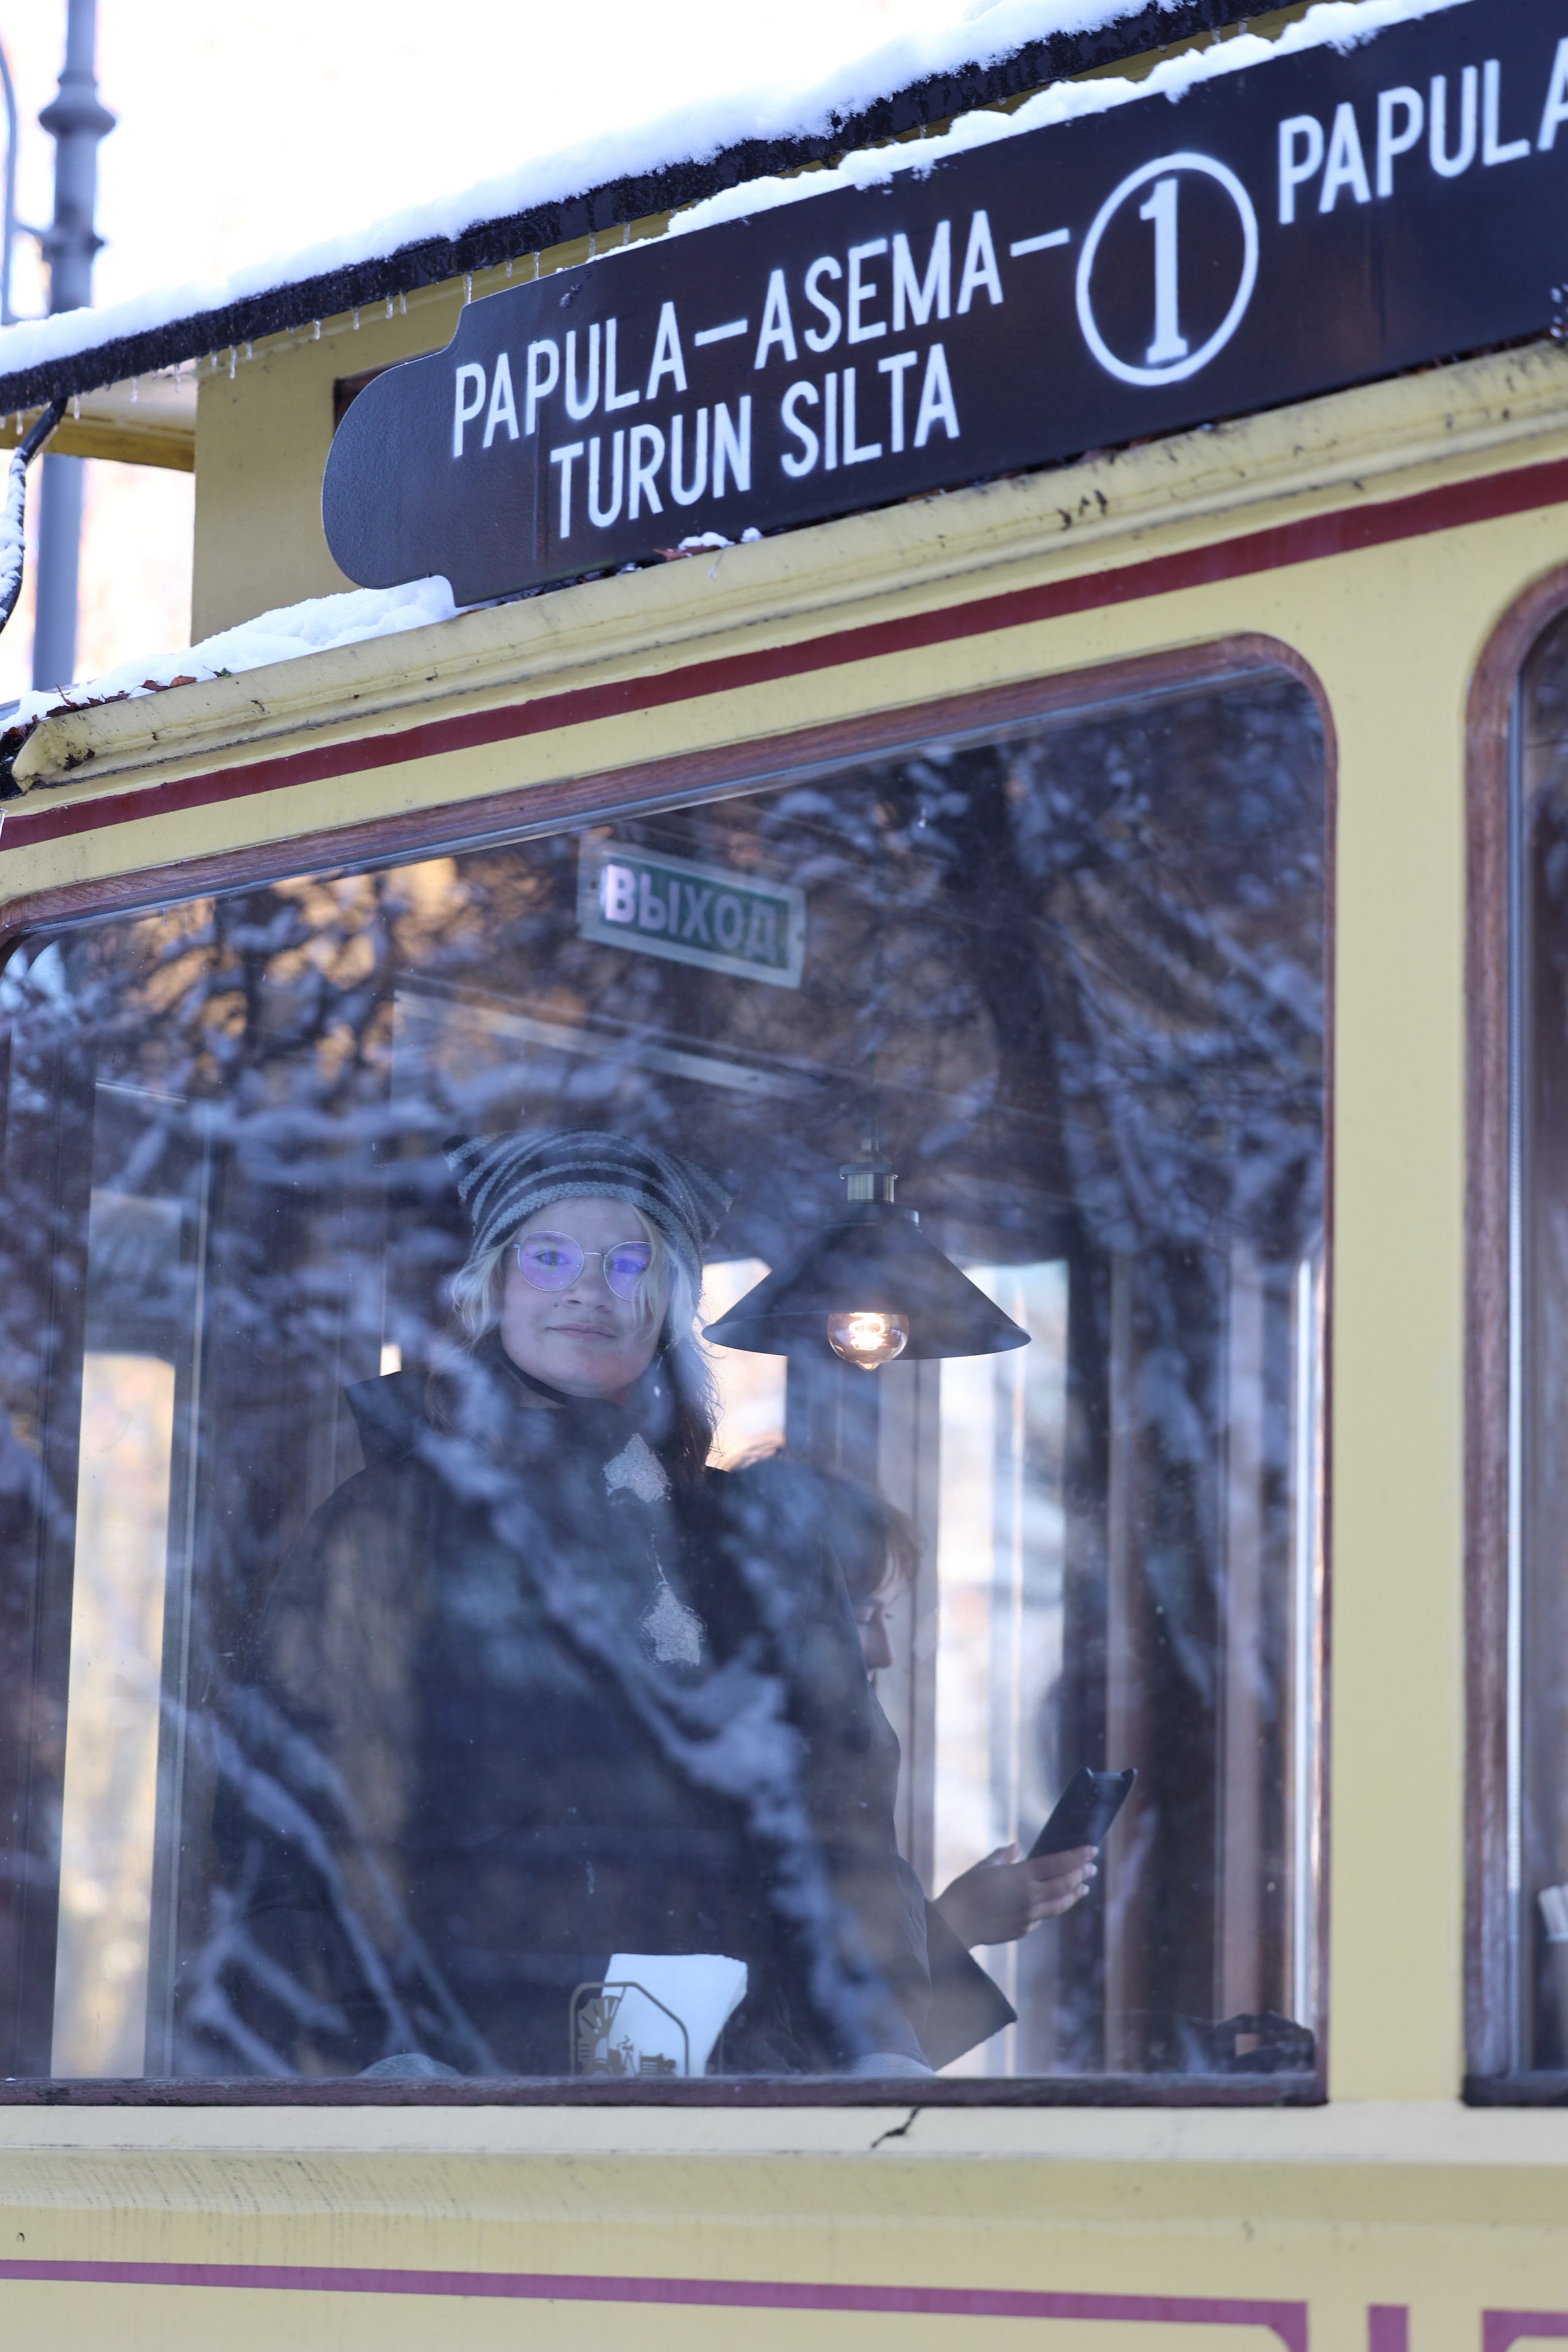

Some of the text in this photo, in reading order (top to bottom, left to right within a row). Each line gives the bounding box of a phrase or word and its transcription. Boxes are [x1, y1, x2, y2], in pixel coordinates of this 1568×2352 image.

[1139, 178, 1189, 366] 1
[549, 342, 960, 540] TURUN SILTA
[604, 864, 777, 963] ВЫХОД
